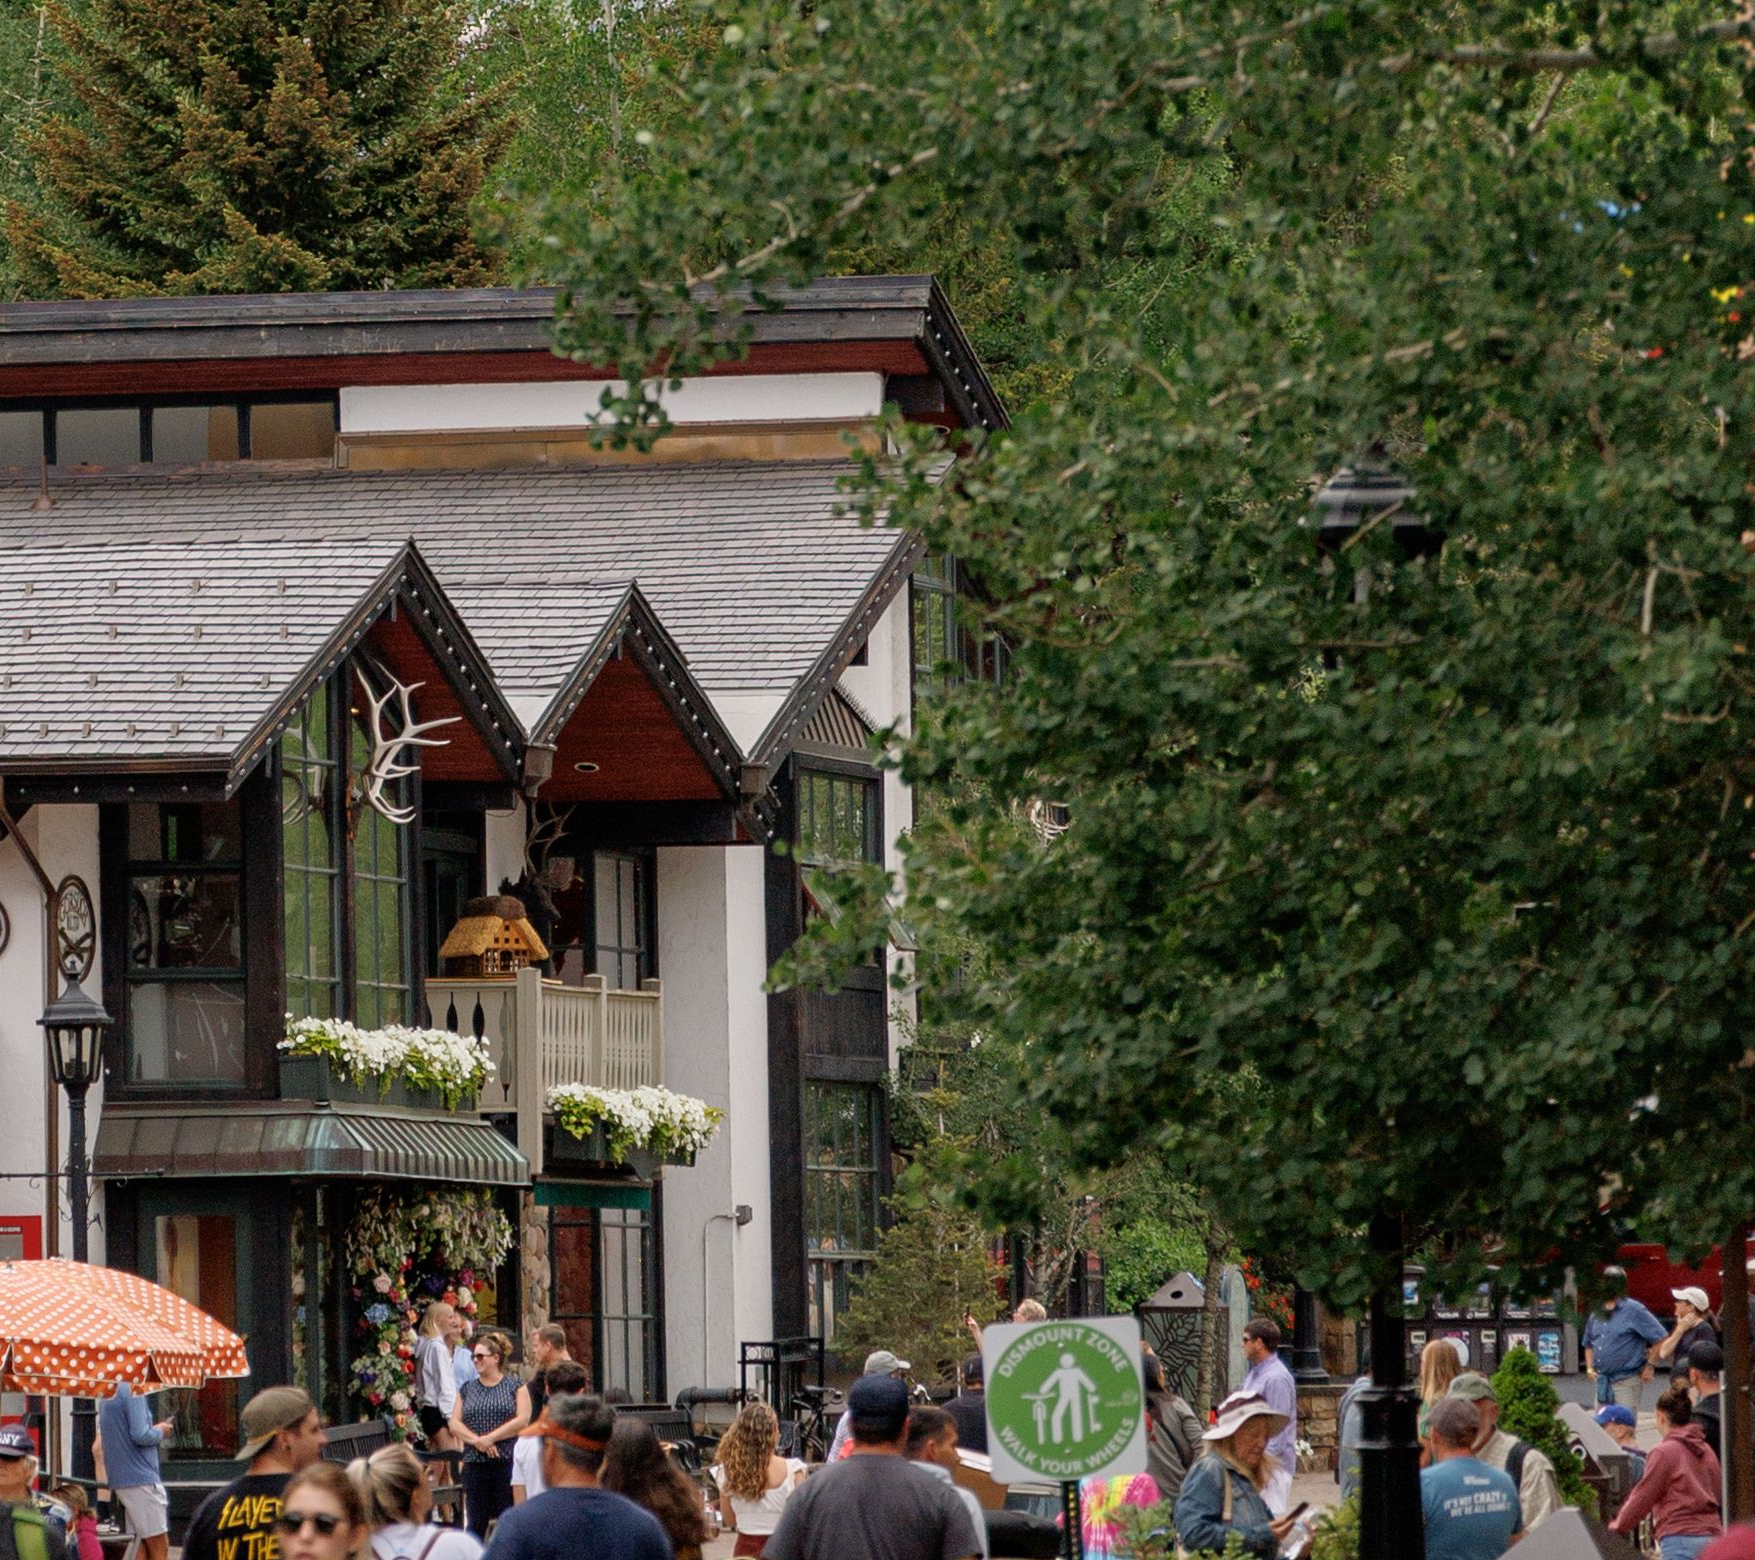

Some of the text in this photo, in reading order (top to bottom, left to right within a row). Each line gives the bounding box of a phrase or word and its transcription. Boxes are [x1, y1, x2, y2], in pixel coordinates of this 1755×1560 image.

[998, 1327, 1130, 1378] DISMOUNT ZONE
[999, 1418, 1135, 1475] WALK YOUR WHEELS
